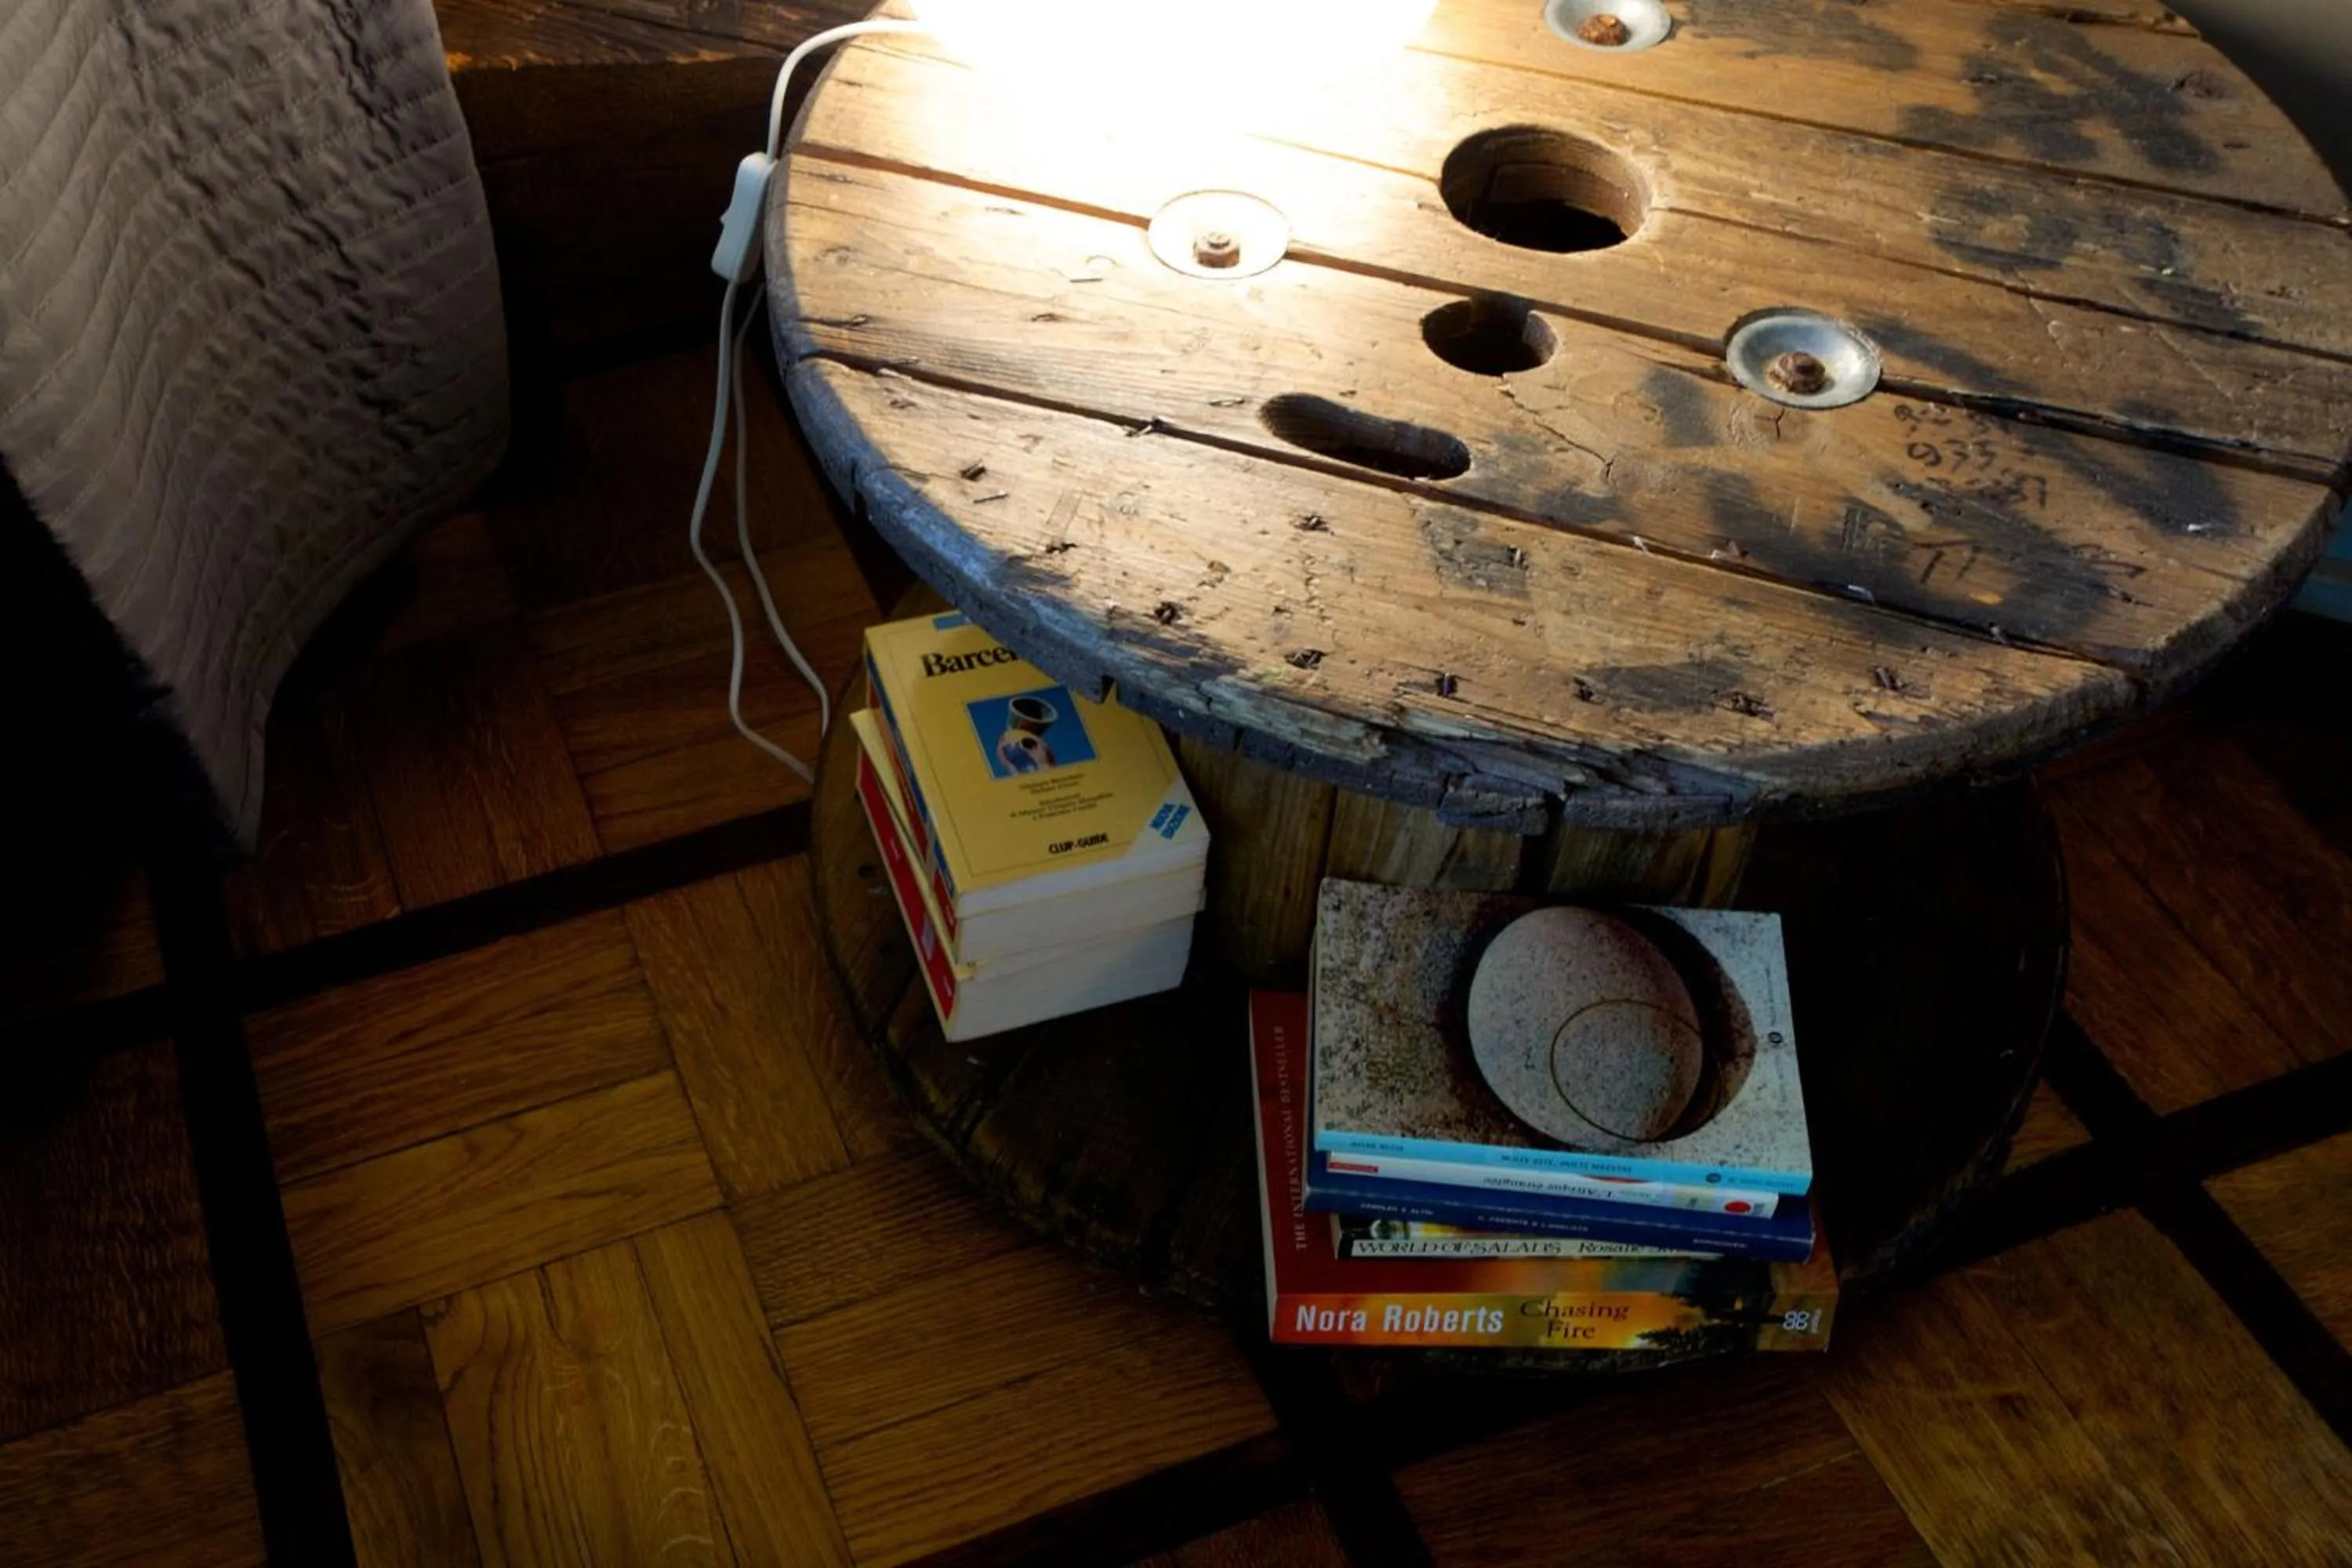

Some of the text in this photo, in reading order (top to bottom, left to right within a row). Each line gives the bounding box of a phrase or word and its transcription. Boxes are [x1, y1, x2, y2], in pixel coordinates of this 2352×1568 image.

[1273, 1025, 1308, 1252] THE INTERNATIONAL BESTSELLER
[1359, 1241, 1439, 1253] WORLD
[1472, 1242, 1563, 1254] SALADS
[1295, 1304, 1504, 1334] Nora Roberts
[1519, 1298, 1631, 1322] Chasing
[1546, 1321, 1597, 1340] Fire
